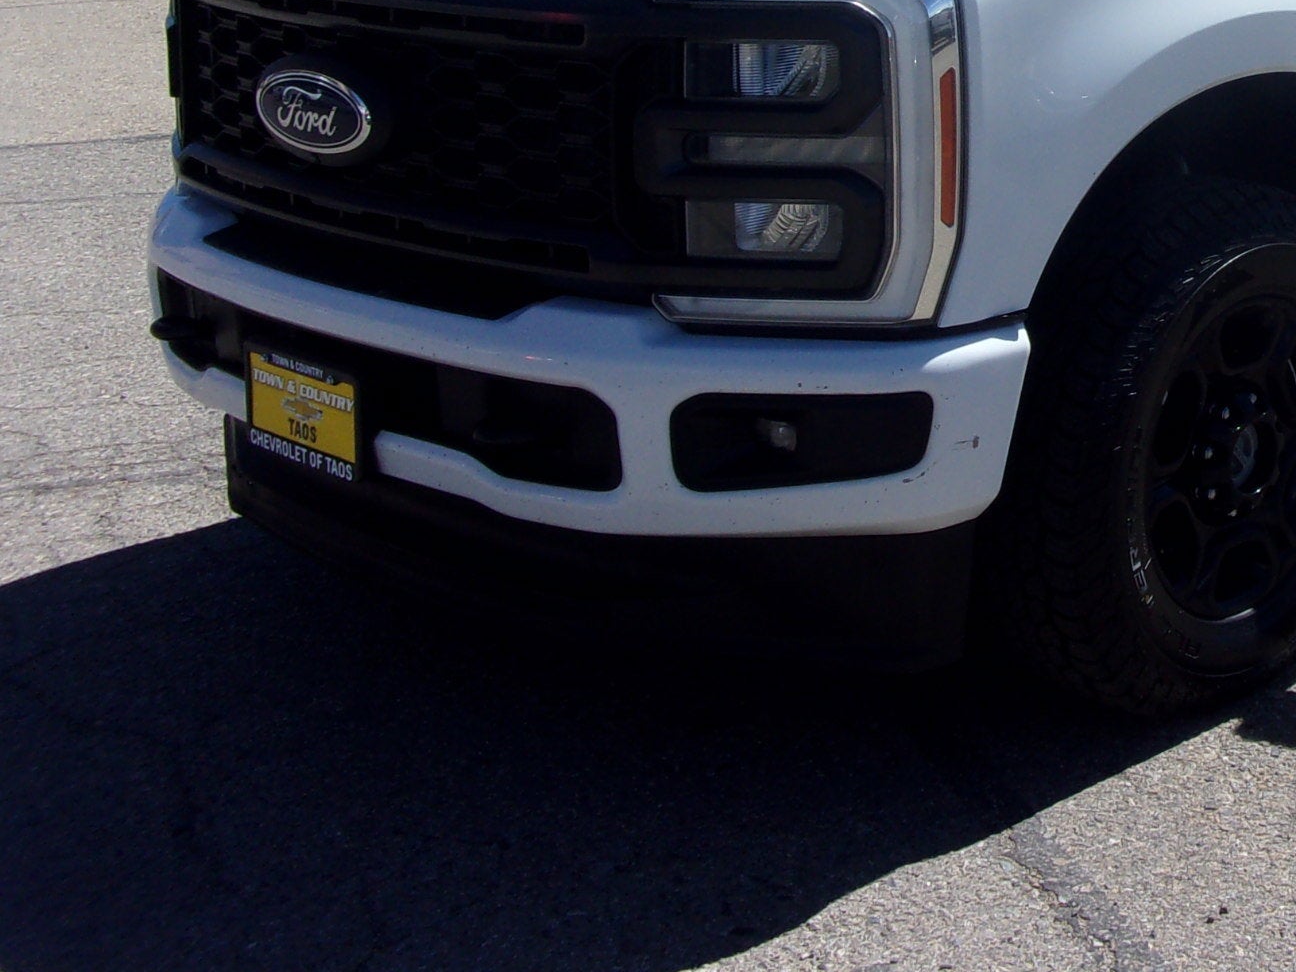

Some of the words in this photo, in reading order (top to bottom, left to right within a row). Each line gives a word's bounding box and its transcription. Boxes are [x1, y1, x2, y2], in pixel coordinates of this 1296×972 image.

[277, 85, 338, 137] Ford
[271, 353, 289, 369] TOWN
[295, 362, 324, 378] COUNTRY
[252, 368, 284, 390] TOWN
[286, 380, 297, 394] &
[299, 384, 354, 412] COUNTRY
[289, 419, 317, 443] TAOS
[250, 428, 308, 463] CHEVROLET
[309, 451, 324, 469] OF
[325, 457, 353, 482] TAOS
